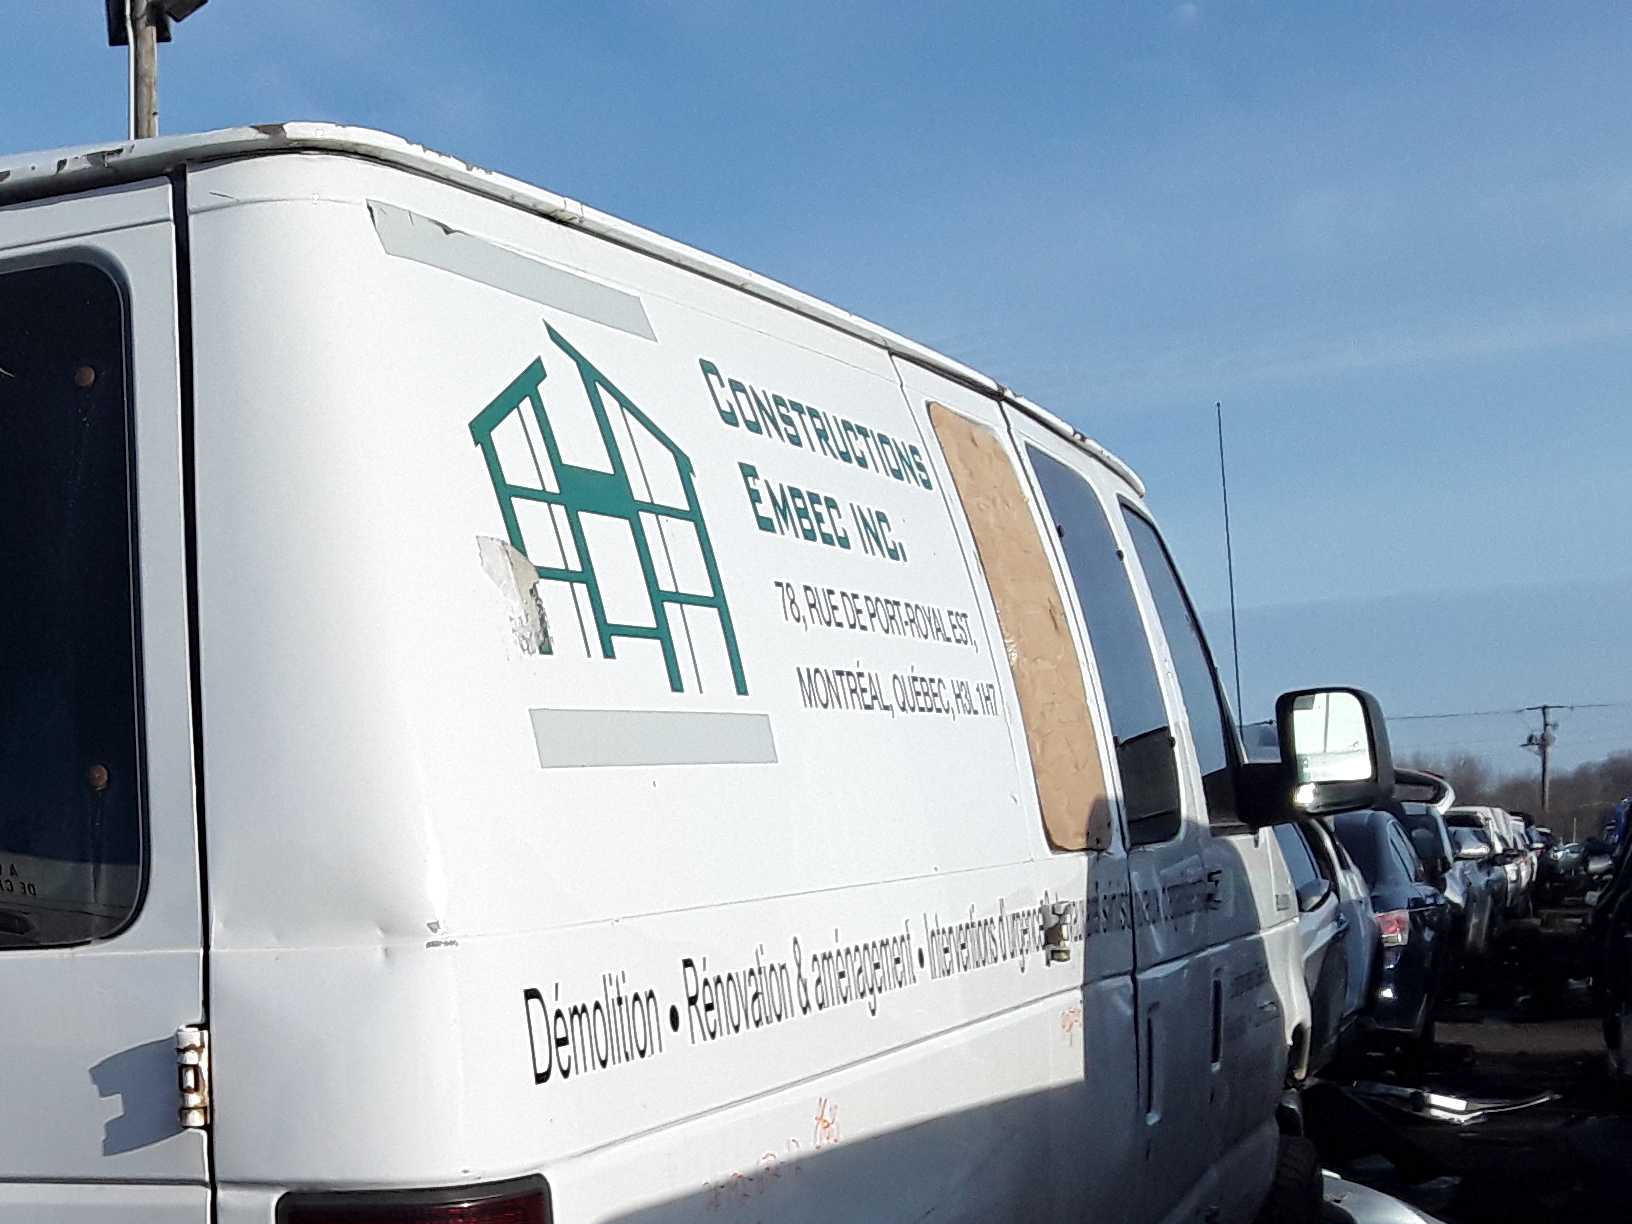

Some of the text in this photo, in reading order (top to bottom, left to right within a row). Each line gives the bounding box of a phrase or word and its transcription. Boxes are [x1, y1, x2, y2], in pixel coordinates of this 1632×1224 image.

[698, 358, 933, 491] CONSTRUCTIONS
[737, 461, 852, 550] EMBEC
[774, 581, 979, 653] 78, RUE DE PORT-ROYAL EST,
[796, 660, 895, 718] MONTRÉAL,
[892, 665, 956, 721] QUÉBEC,
[949, 679, 979, 715] H3L
[523, 969, 664, 1085] Démolition
[682, 943, 795, 1044] Rénovation
[811, 918, 917, 1016] aménagement
[923, 903, 998, 982] Interventions
